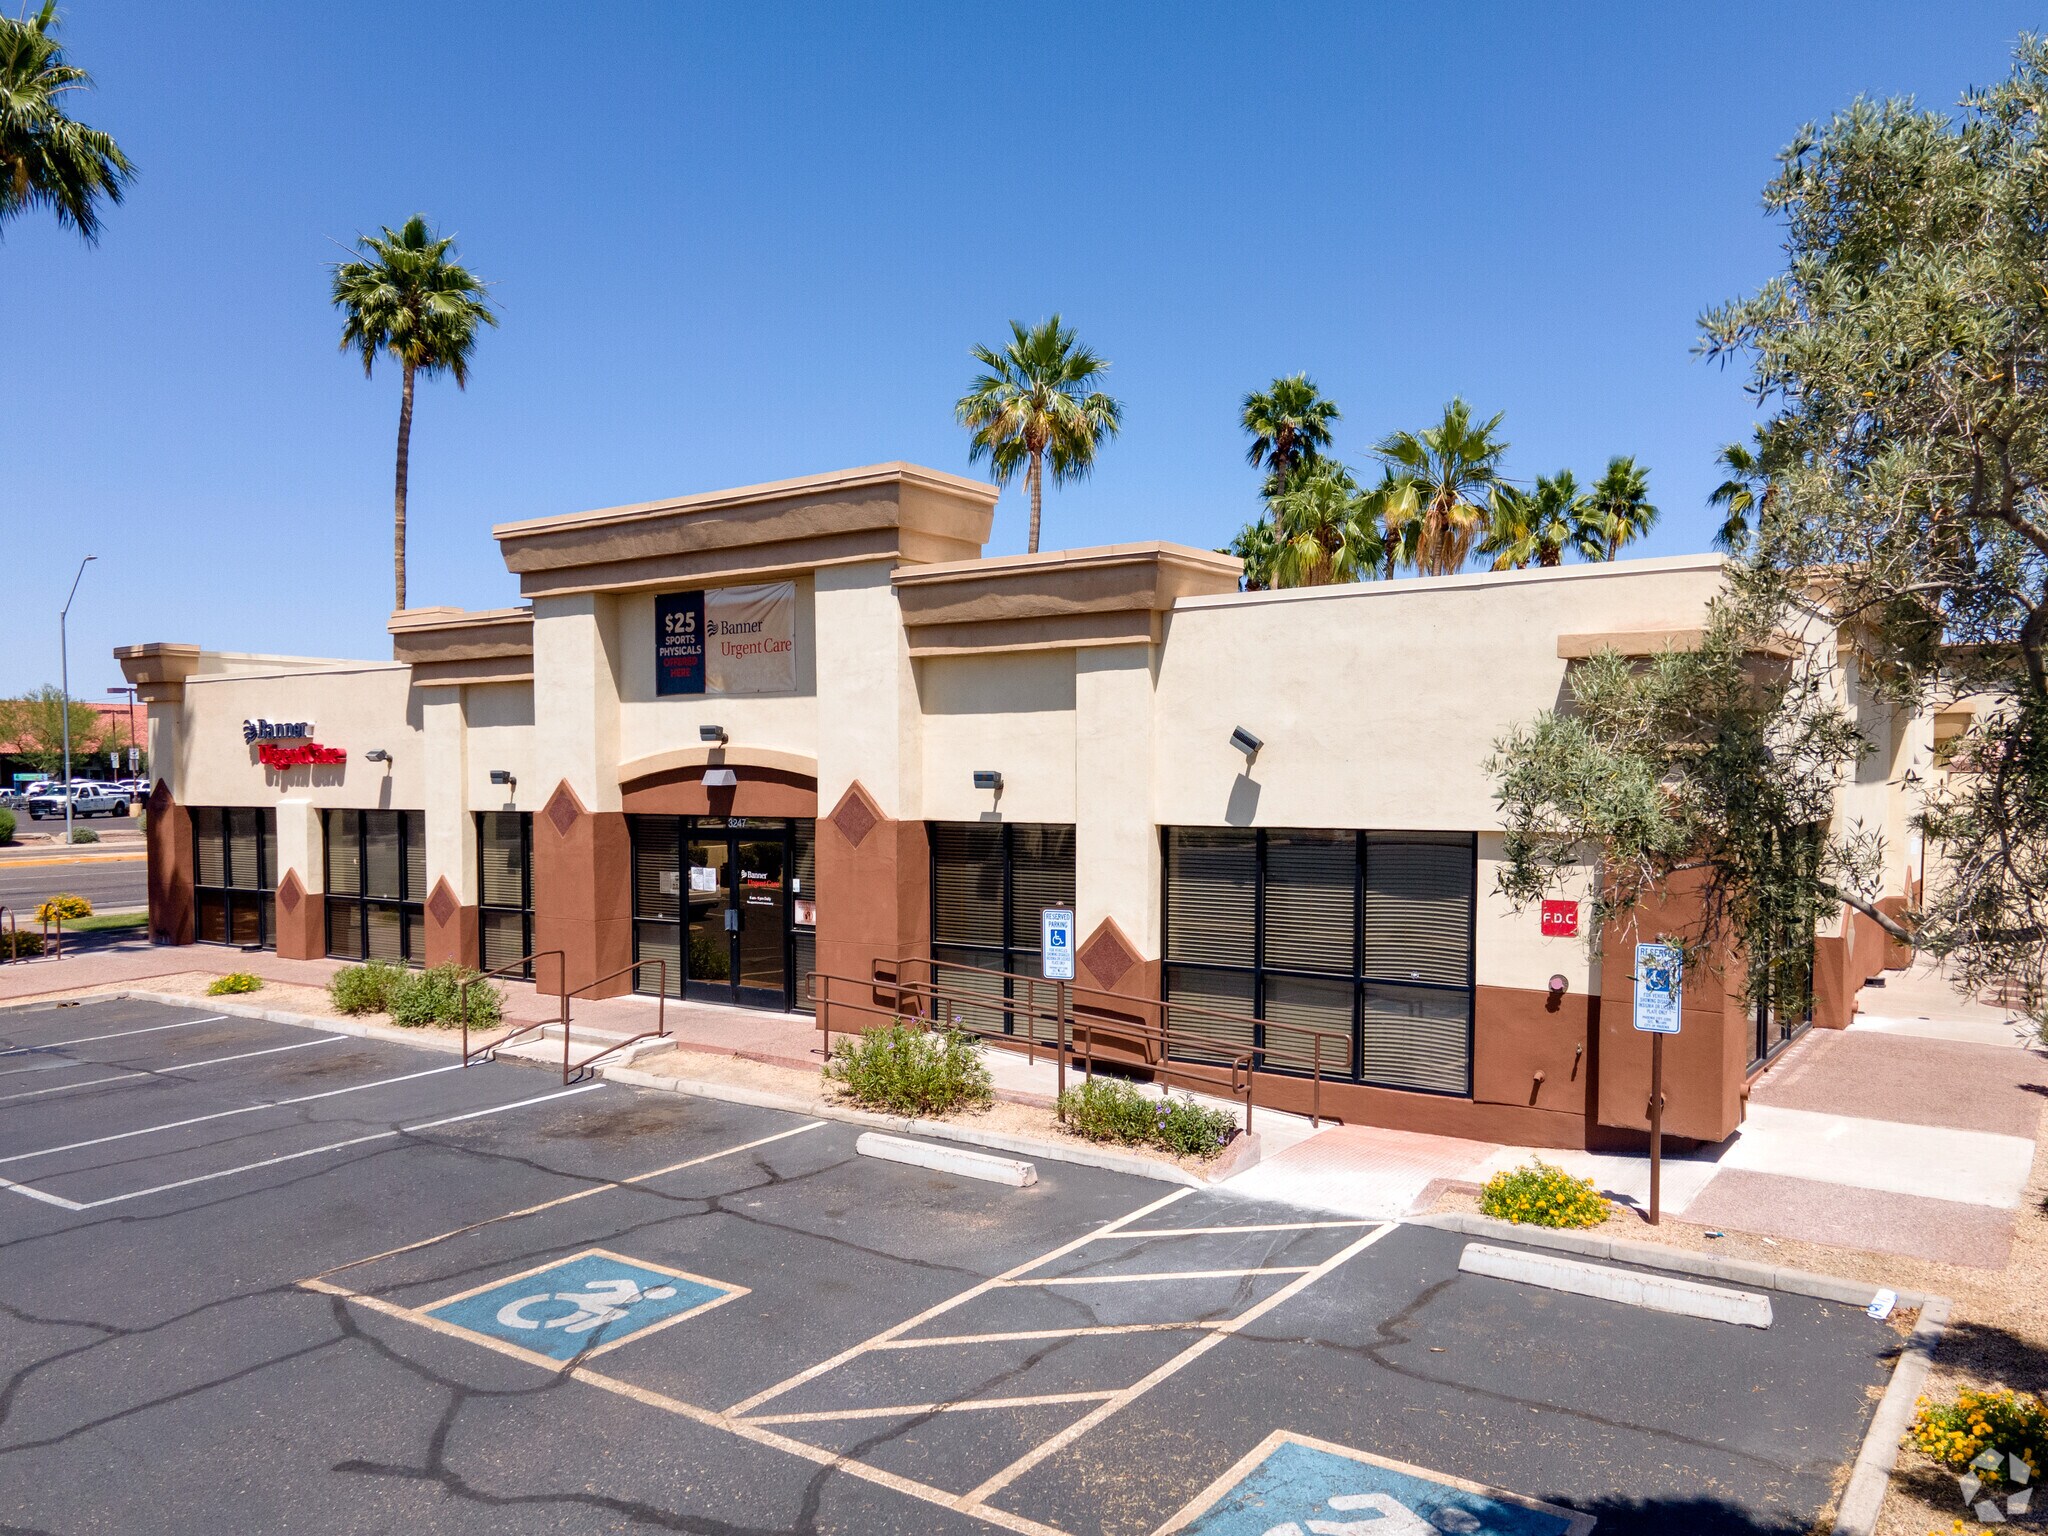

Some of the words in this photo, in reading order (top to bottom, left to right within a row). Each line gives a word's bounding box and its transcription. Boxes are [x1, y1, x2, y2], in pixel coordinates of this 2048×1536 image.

[665, 612, 696, 633] $25
[721, 620, 763, 635] Banner
[665, 635, 695, 646] SPORTS
[659, 645, 702, 657] PHYSICALS
[721, 641, 762, 660] Urgent
[763, 638, 792, 654] Care
[663, 657, 698, 667] OFFERED
[670, 668, 691, 678] HERE
[257, 719, 308, 739] Banner
[728, 818, 747, 828] 3247
[747, 870, 768, 879] Banner
[1543, 912, 1577, 924] F.D.C.
[1048, 920, 1068, 928] PARKING
